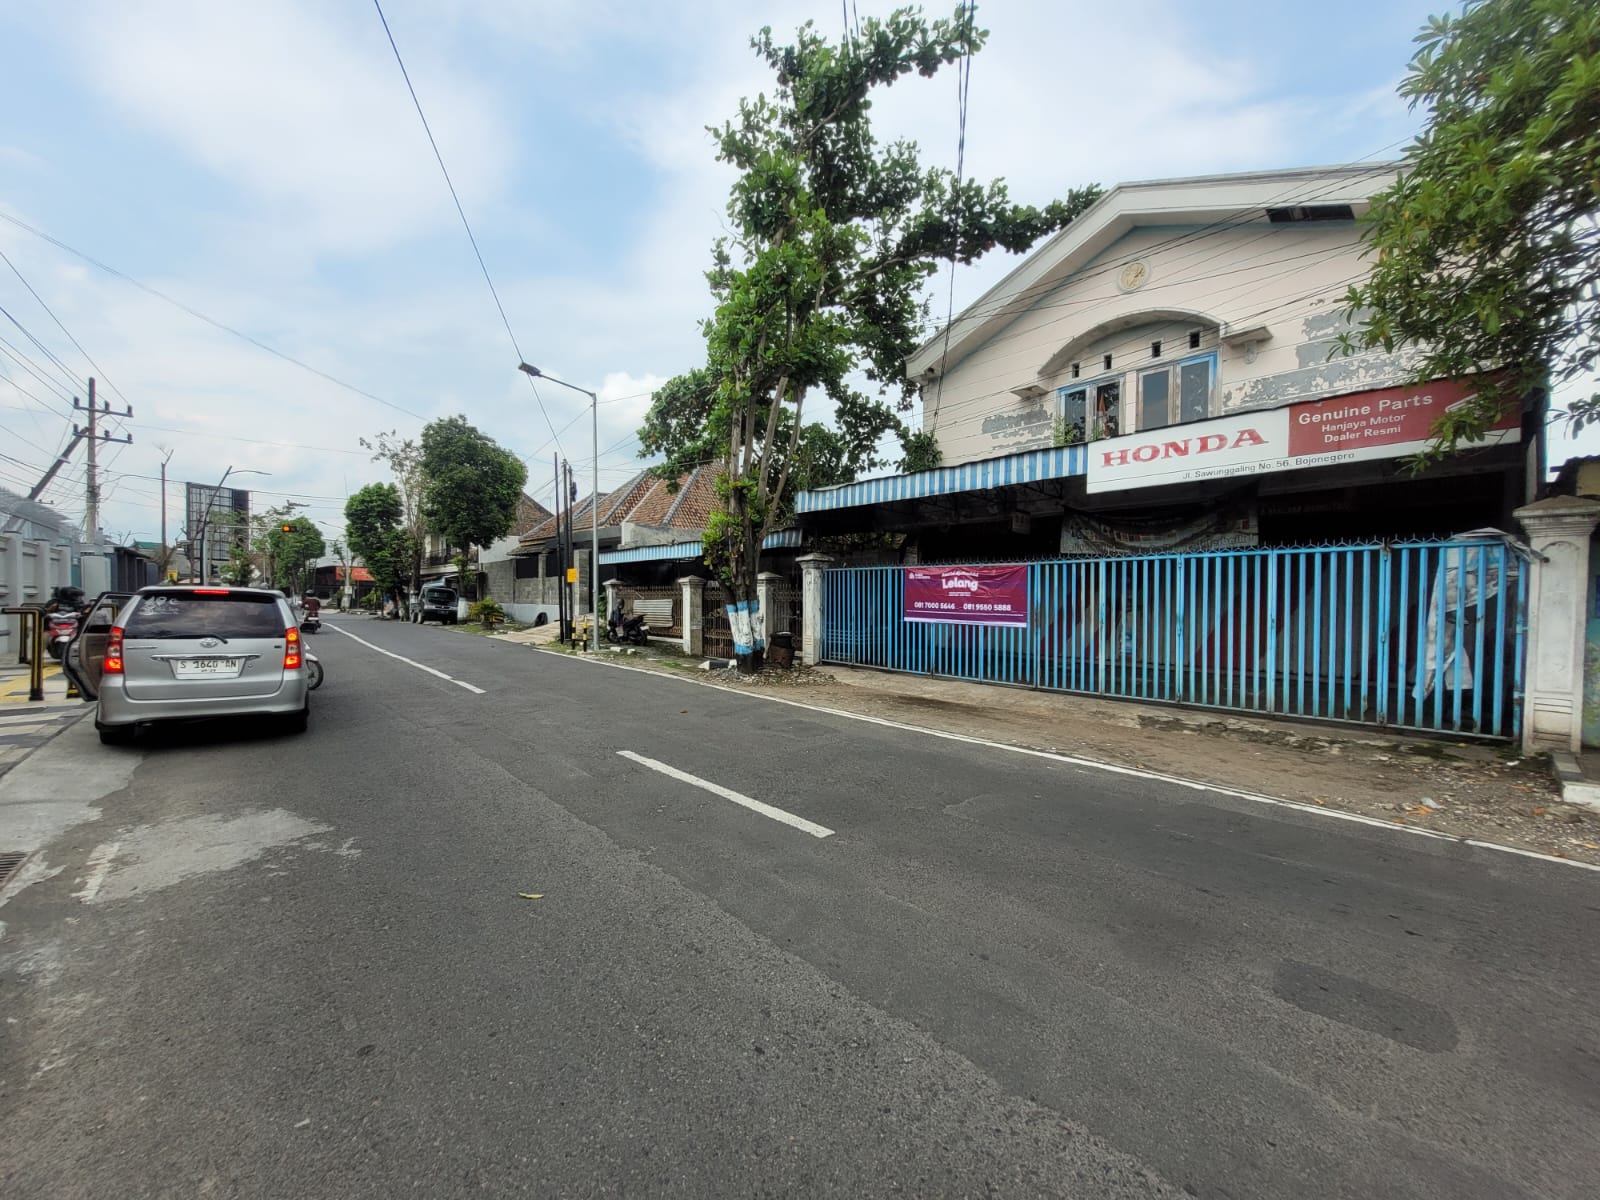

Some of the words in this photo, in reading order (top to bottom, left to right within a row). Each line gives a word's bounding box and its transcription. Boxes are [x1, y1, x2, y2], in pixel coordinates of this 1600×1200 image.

[1298, 405, 1371, 425] Genuine
[1378, 395, 1433, 412] Parts
[1321, 419, 1367, 433] Hanjaya
[1369, 414, 1407, 426] Motor
[1324, 431, 1361, 443] Dealer
[1364, 425, 1401, 437] Resmi
[1102, 429, 1269, 467] HONDA
[1194, 465, 1256, 478] Sawunggaling
[1295, 453, 1356, 466] Bojonegoro
[941, 577, 979, 591] Lelang
